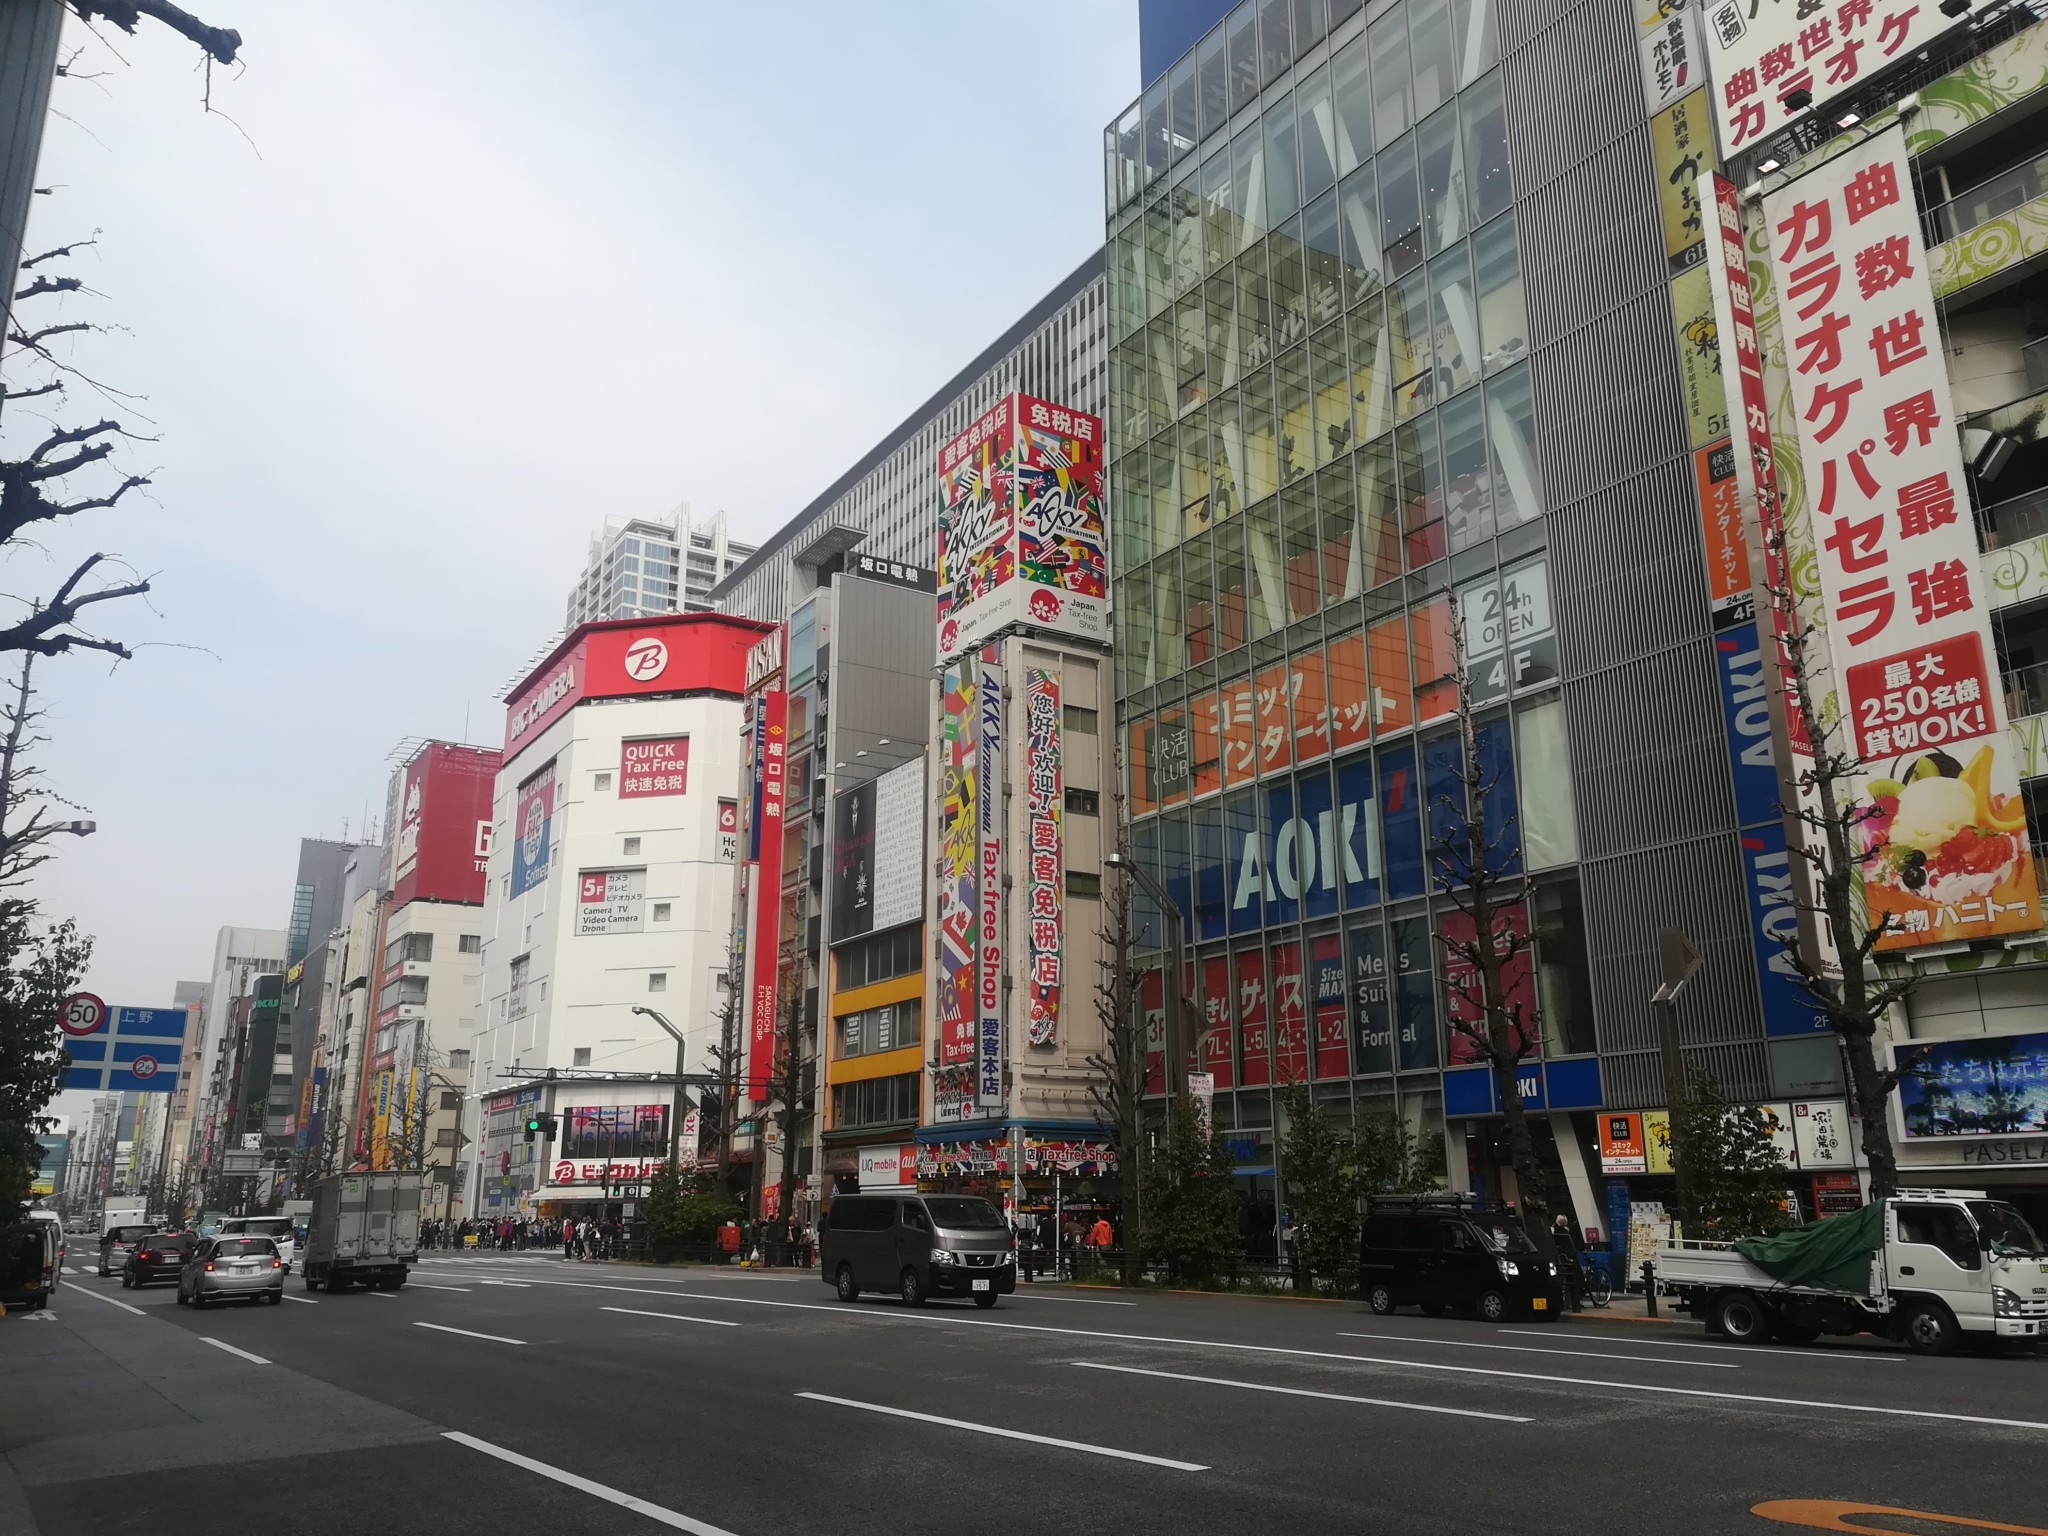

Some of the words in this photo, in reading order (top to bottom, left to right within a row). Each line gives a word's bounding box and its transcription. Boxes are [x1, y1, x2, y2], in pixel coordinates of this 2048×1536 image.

[1652, 39, 1674, 100] ホルモン
[944, 402, 1008, 470] 愛客免税店
[1030, 403, 1093, 441] 免税店
[1777, 200, 1896, 647] カラオケパセラ
[1026, 489, 1084, 538] AKKY
[969, 523, 1006, 551] INTERNATIONAL
[1055, 524, 1099, 542] INTERNATIONAL
[1713, 484, 1738, 591] インターネット
[860, 556, 919, 583] 坂口電熱
[1067, 607, 1098, 622] Tax-free
[1070, 598, 1098, 613] Japan.
[1481, 580, 1533, 622] 24h
[1078, 618, 1098, 632] Shop
[1482, 611, 1534, 645] OPEN
[1487, 650, 1533, 690] 4F
[1884, 652, 1946, 691] 最大
[528, 664, 575, 724] CAMERA
[1209, 672, 1304, 734] コミック
[1860, 677, 1982, 728] 250名様
[982, 670, 1000, 752] AKKY
[1223, 686, 1397, 777] インターネット
[1864, 705, 1987, 757] 貸切OK!
[625, 761, 651, 774] Tax
[652, 758, 685, 772] Free
[626, 743, 676, 760] QUICK
[624, 774, 683, 793] 快速免税
[766, 741, 782, 817] 坂口電熱
[982, 728, 1000, 835] INTERNATIONAL
[1232, 797, 1380, 910] AOKI
[583, 878, 604, 897] 5F
[607, 884, 628, 893] テレビ
[608, 874, 629, 883] カメラ
[982, 838, 1000, 941] Tax-free
[583, 907, 612, 915] Camera
[617, 905, 628, 913] TV
[606, 893, 643, 902] ビデオカメラ
[1031, 816, 1058, 987] 愛客免税店
[582, 925, 606, 933] Drone
[583, 916, 606, 925] Video
[607, 914, 638, 923] Camera
[982, 946, 1000, 1010] Shop
[69, 1004, 96, 1024] 50
[120, 1010, 154, 1024] 上野
[764, 985, 772, 1034] SAKAGUCHI
[1361, 1010, 1370, 1024] &
[981, 1017, 1000, 1096] 愛客本店
[312, 1084, 322, 1114] animate
[378, 1074, 390, 1116] TRADERS
[861, 1158, 874, 1173] UQ
[873, 1157, 897, 1170] mobile
[901, 1155, 916, 1169] au
[1041, 1148, 1088, 1162] Tax-free
[1088, 1149, 1116, 1163] Shop
[1605, 1148, 1640, 1156] インターネット
[434, 1184, 441, 1193] P
